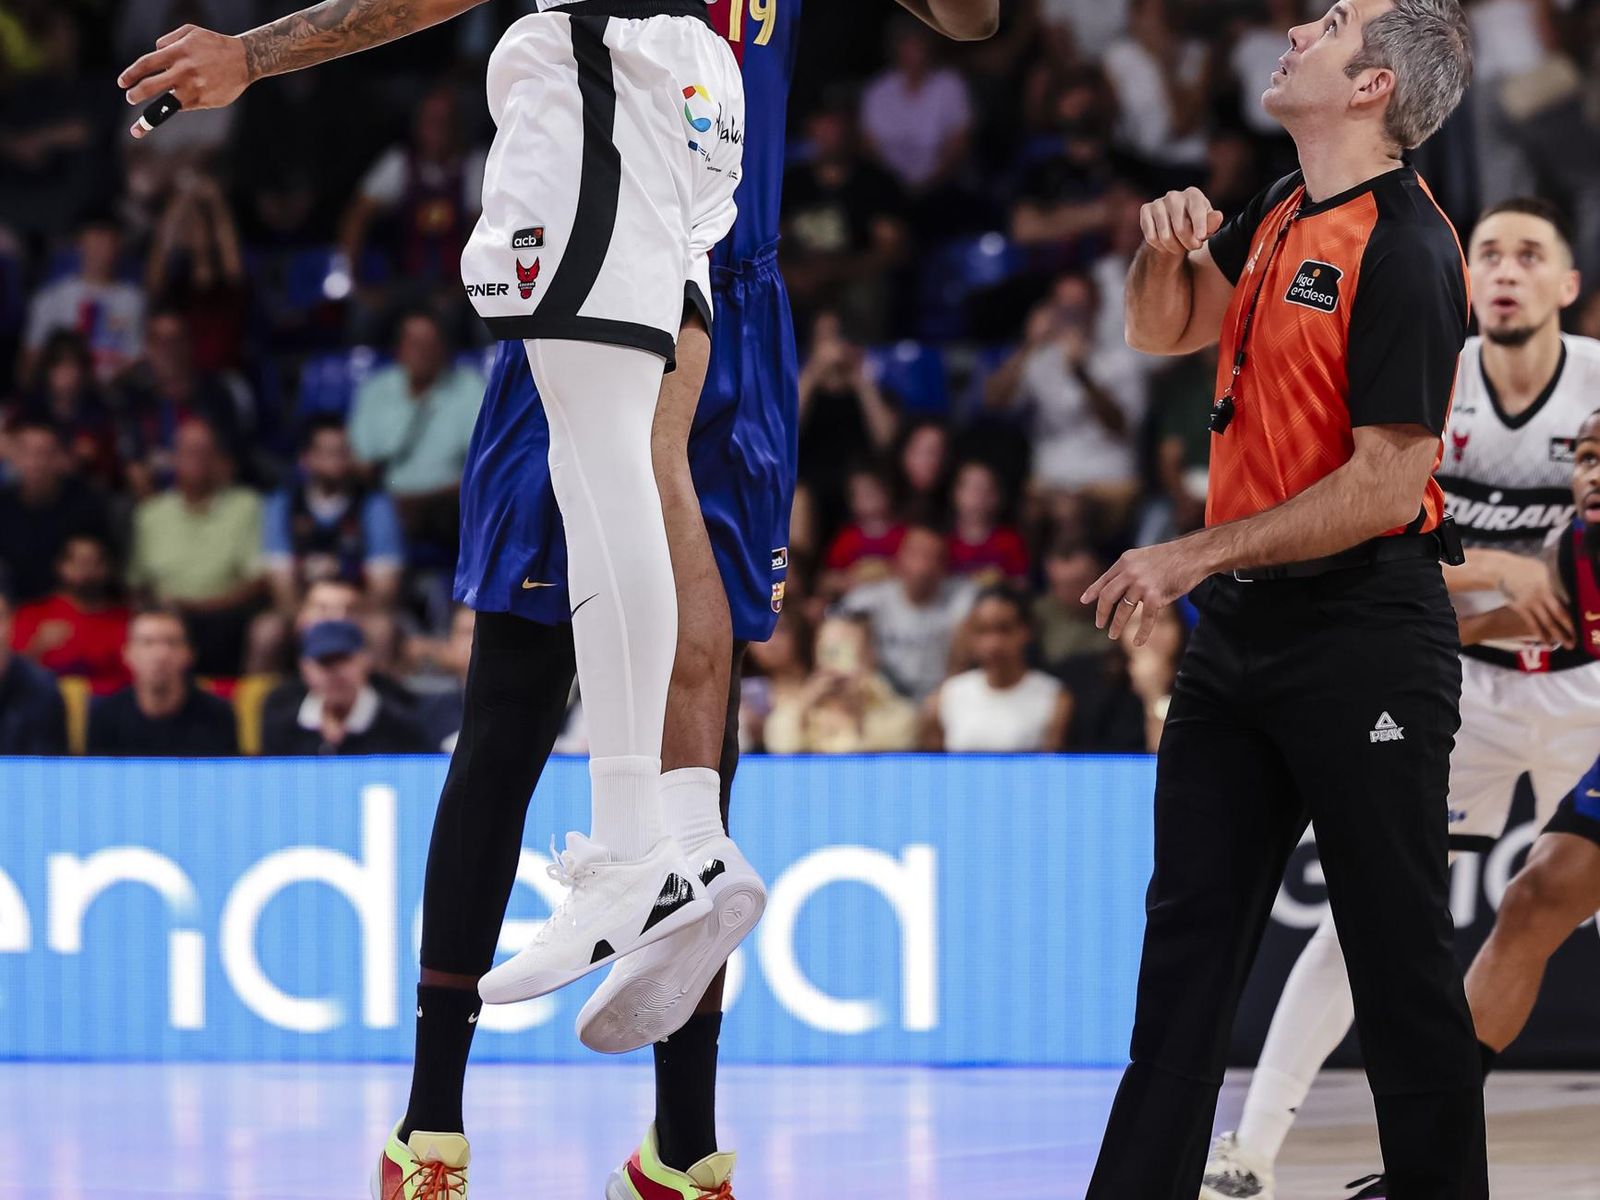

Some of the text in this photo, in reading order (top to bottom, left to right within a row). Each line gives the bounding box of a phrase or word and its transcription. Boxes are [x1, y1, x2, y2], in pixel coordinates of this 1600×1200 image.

[514, 235, 537, 247] acb
[1296, 273, 1315, 287] liga
[466, 282, 510, 297] RNER
[1290, 286, 1334, 306] endesa
[1369, 726, 1405, 743] PEAK
